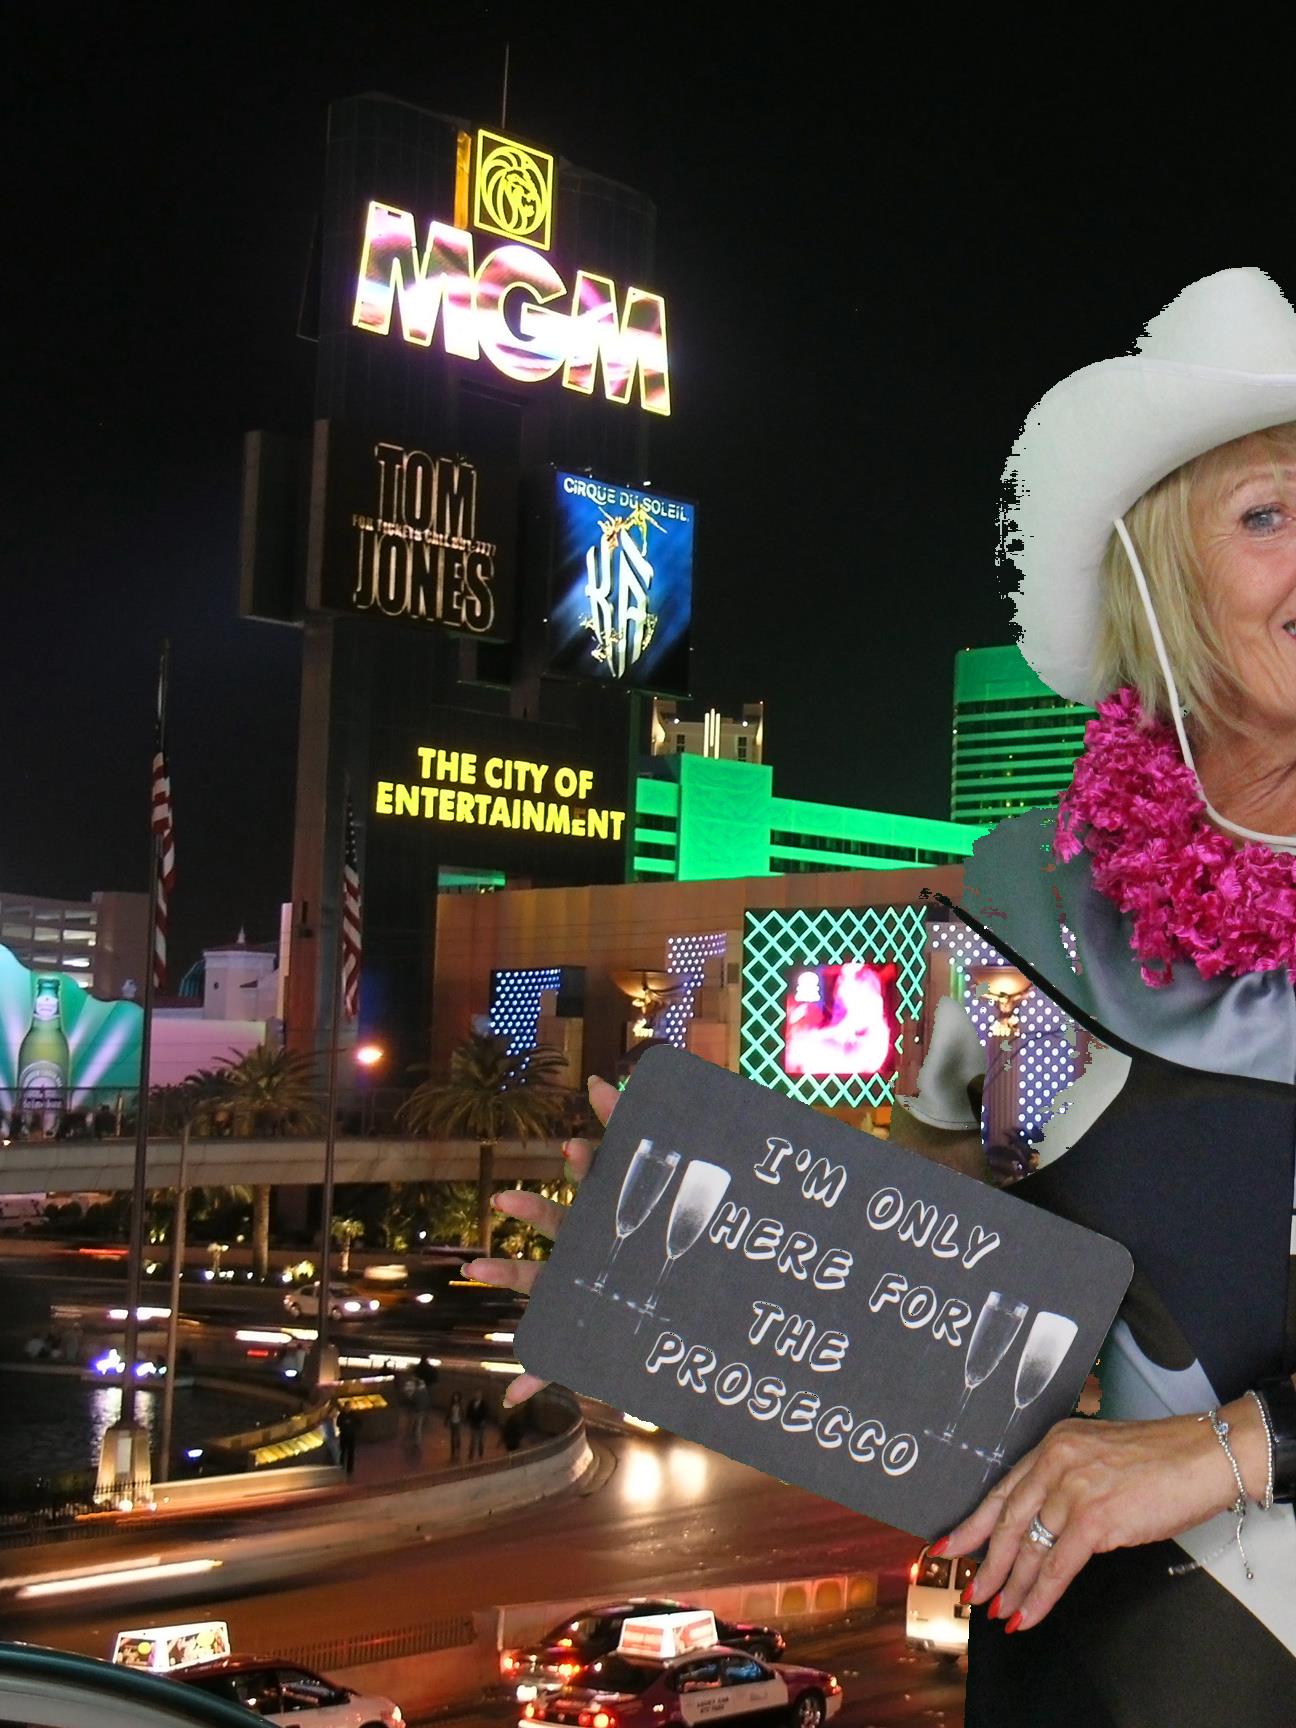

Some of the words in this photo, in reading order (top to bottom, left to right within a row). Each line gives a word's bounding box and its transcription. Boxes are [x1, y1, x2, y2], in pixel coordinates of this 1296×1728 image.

[352, 200, 671, 417] MGM
[374, 442, 478, 540] TOM
[563, 476, 617, 506] CIRQUE
[619, 491, 639, 510] DU
[352, 529, 495, 632] JONES
[375, 781, 626, 841] ENTERTAINMENT
[417, 746, 477, 785] THE
[483, 757, 549, 794] CITY
[554, 766, 594, 800] OF
[753, 1136, 847, 1209] I'M
[866, 1186, 1001, 1270] ONLY
[708, 1201, 854, 1291] HERE
[867, 1272, 973, 1347] FOR
[748, 1300, 850, 1373] THE
[645, 1331, 919, 1477] PROSECCO
